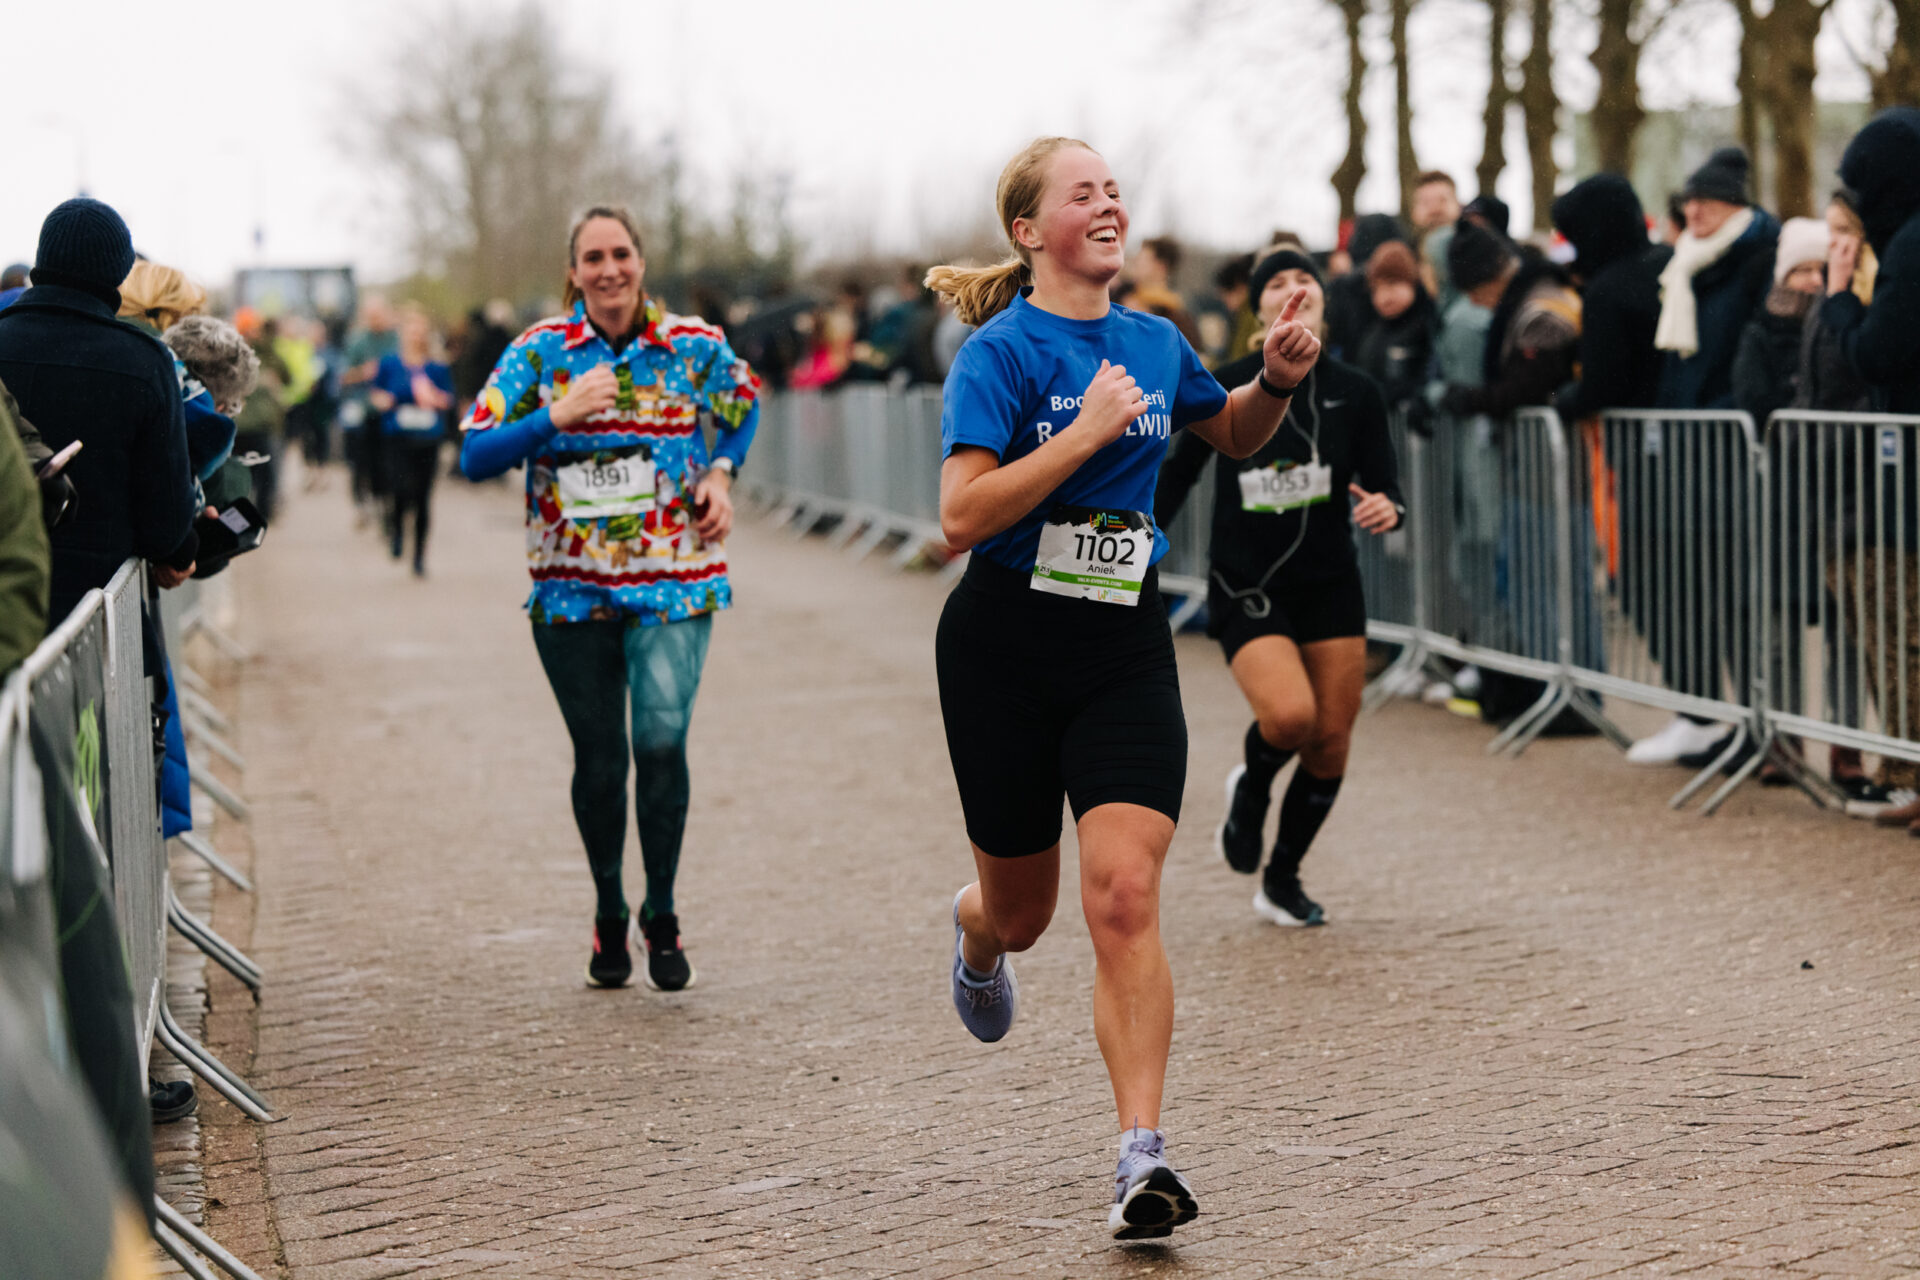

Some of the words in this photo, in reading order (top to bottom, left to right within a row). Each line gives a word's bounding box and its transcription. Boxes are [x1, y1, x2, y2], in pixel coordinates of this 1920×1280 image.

[582, 465, 631, 488] 1891
[1260, 471, 1311, 495] 1053
[1074, 533, 1136, 566] 1102
[1086, 563, 1116, 576] Aniek
